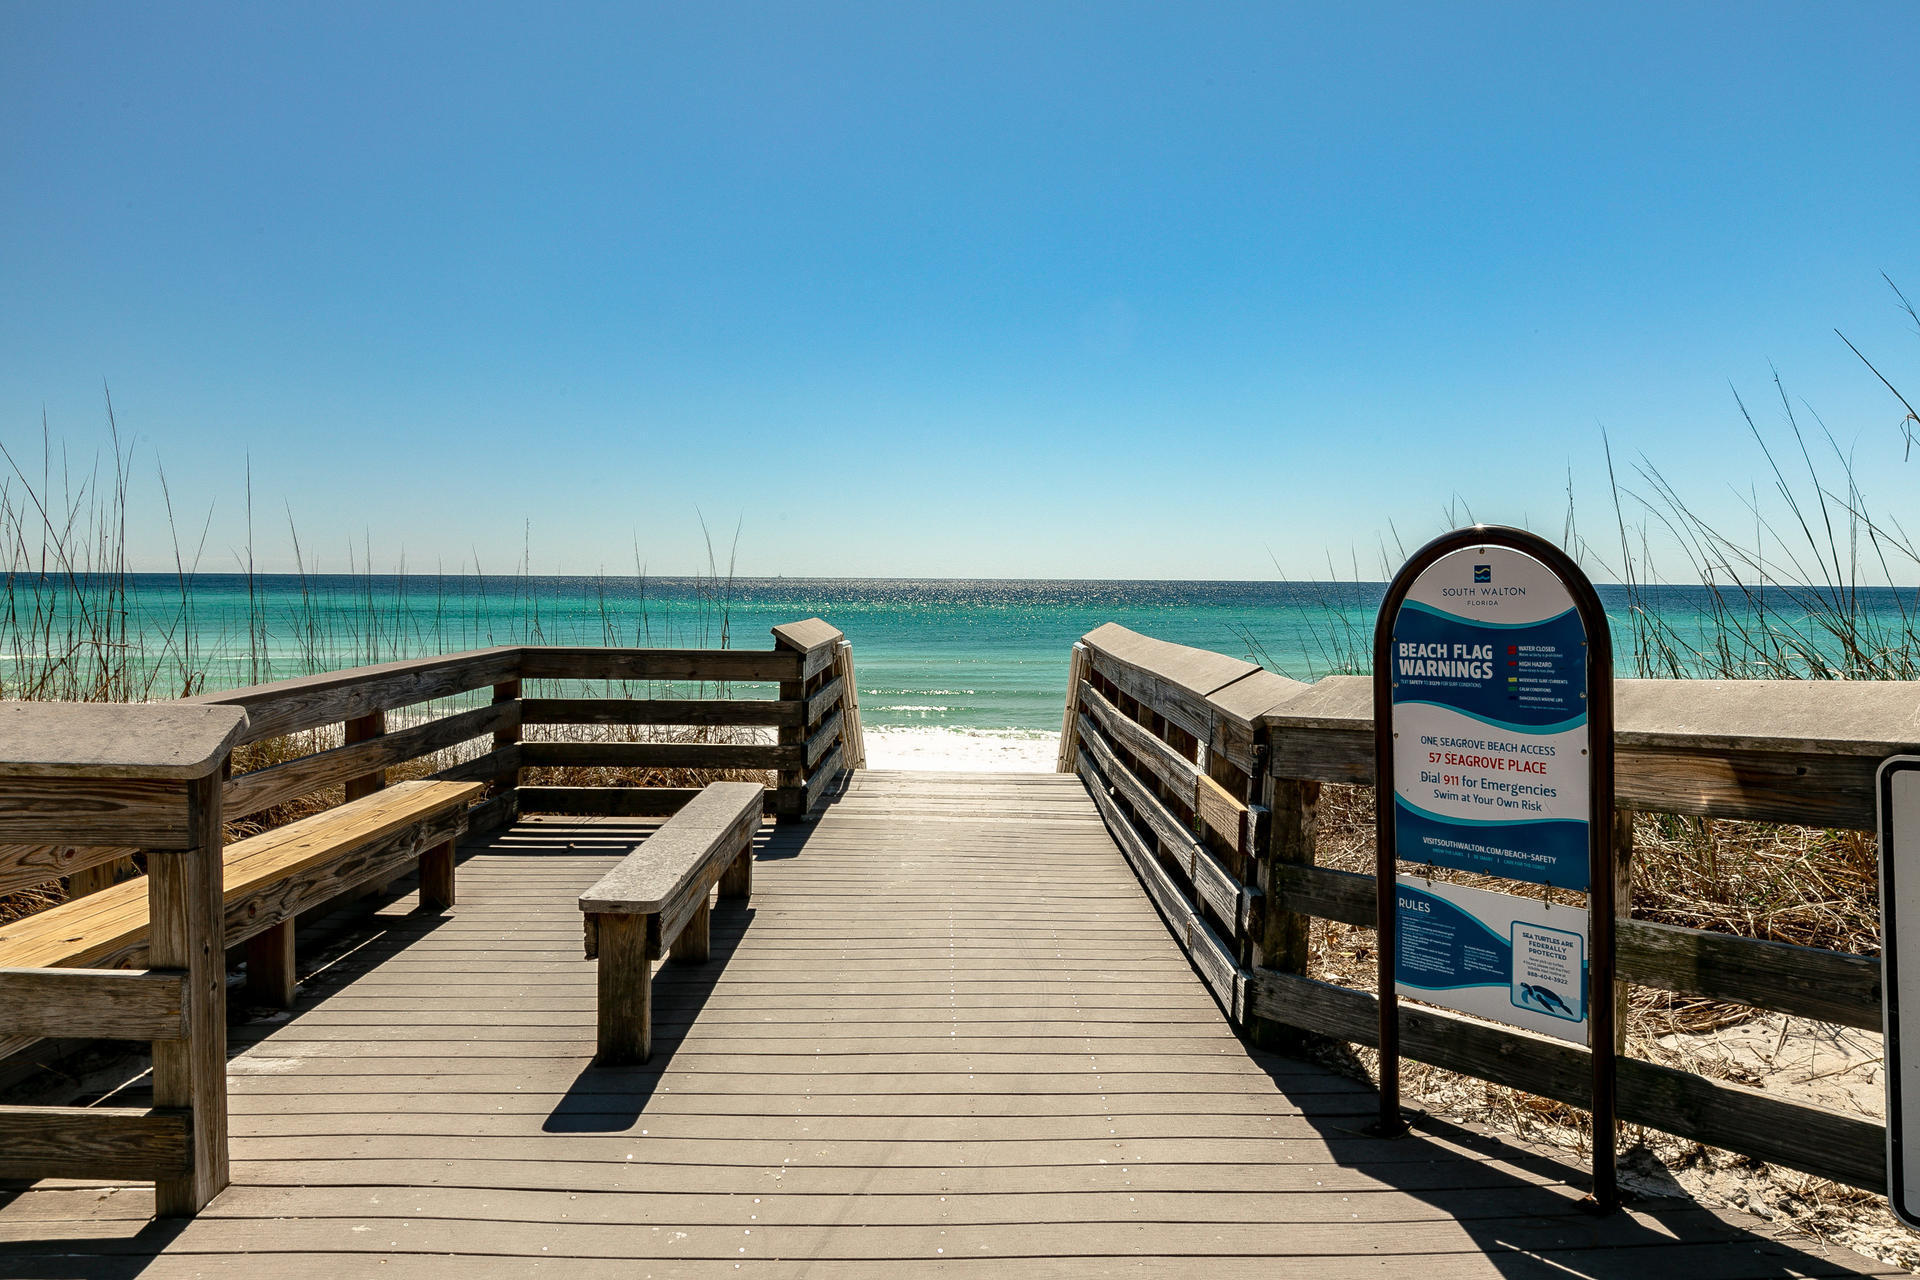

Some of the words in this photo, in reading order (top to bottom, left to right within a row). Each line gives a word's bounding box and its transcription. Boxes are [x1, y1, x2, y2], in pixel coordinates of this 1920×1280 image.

[1442, 587, 1476, 597] SOUTH
[1481, 587, 1526, 596] WALTON
[1399, 643, 1447, 659] BEACH
[1453, 644, 1493, 660] FLAG
[1399, 659, 1494, 680] WARNINGS
[1420, 736, 1438, 746] ONE
[1440, 737, 1485, 750] SEAGROVE
[1487, 741, 1518, 753] BEACH
[1520, 744, 1556, 757] ACCESS
[1429, 752, 1442, 764] 57
[1444, 753, 1505, 770] SEAGROVE
[1508, 759, 1547, 775] PLACE
[1421, 771, 1441, 784] Dial
[1443, 775, 1459, 786] 911
[1462, 775, 1478, 788] for
[1480, 778, 1557, 798] Emergencies
[1433, 789, 1459, 801] Swim
[1461, 793, 1471, 802] at
[1473, 794, 1494, 806] Your
[1496, 798, 1519, 809] Own
[1521, 801, 1542, 812] Risk
[1422, 836, 1557, 865] VISITSOUTHWALTON.COM/BEACH-SAFETY
[1399, 897, 1431, 913] RULES
[1522, 932, 1534, 940] SEA
[1534, 934, 1560, 945] TURTLES
[1528, 940, 1567, 954] FEDERALLY
[1528, 947, 1567, 961] PROTECTED
